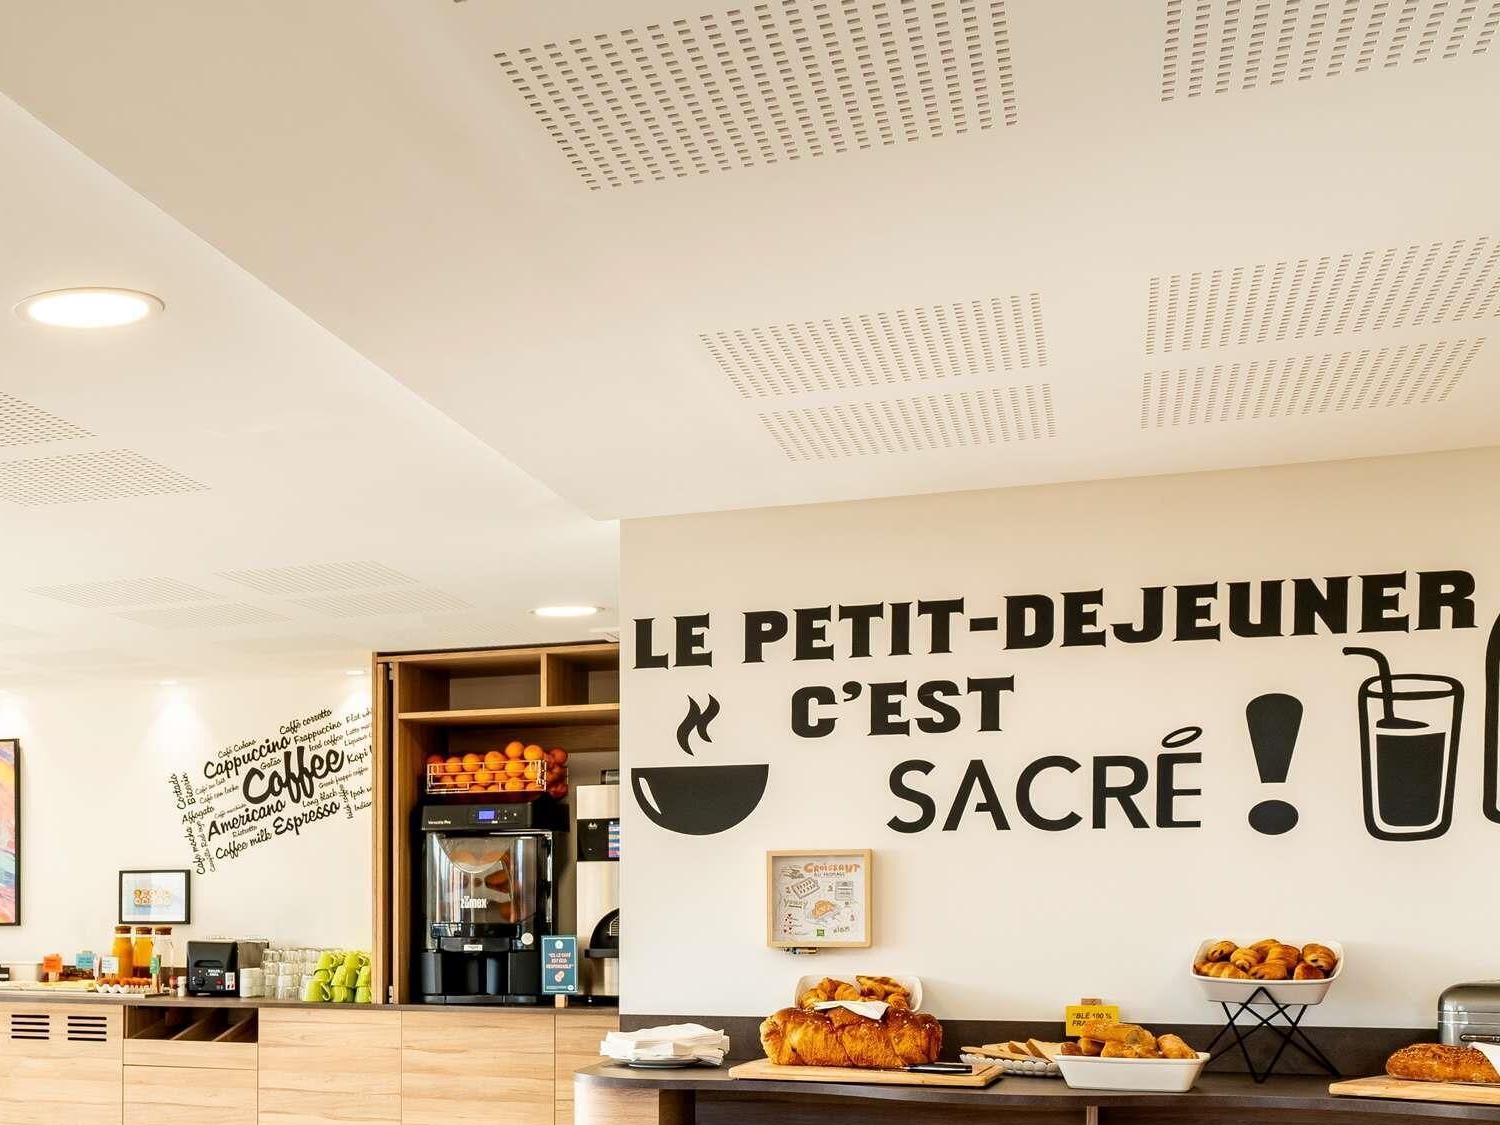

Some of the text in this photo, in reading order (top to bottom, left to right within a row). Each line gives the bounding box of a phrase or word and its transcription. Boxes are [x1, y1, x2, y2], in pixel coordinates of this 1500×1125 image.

[633, 569, 1478, 670] LE PETIT-DEJEUNER
[791, 674, 1015, 738] C'EST
[294, 721, 342, 744] Frappuccino
[204, 736, 291, 779] Cappuccino
[347, 748, 368, 764] Kopi
[169, 773, 186, 810] Cortado
[180, 773, 196, 805] Bicerin
[243, 746, 344, 804] Coffee
[886, 726, 1203, 834] SACRÉ
[182, 806, 214, 824] Affogato
[207, 799, 286, 841] Americano
[273, 801, 341, 836] Espresso
[184, 827, 198, 852] mocha
[215, 828, 273, 859] Coffee milk
